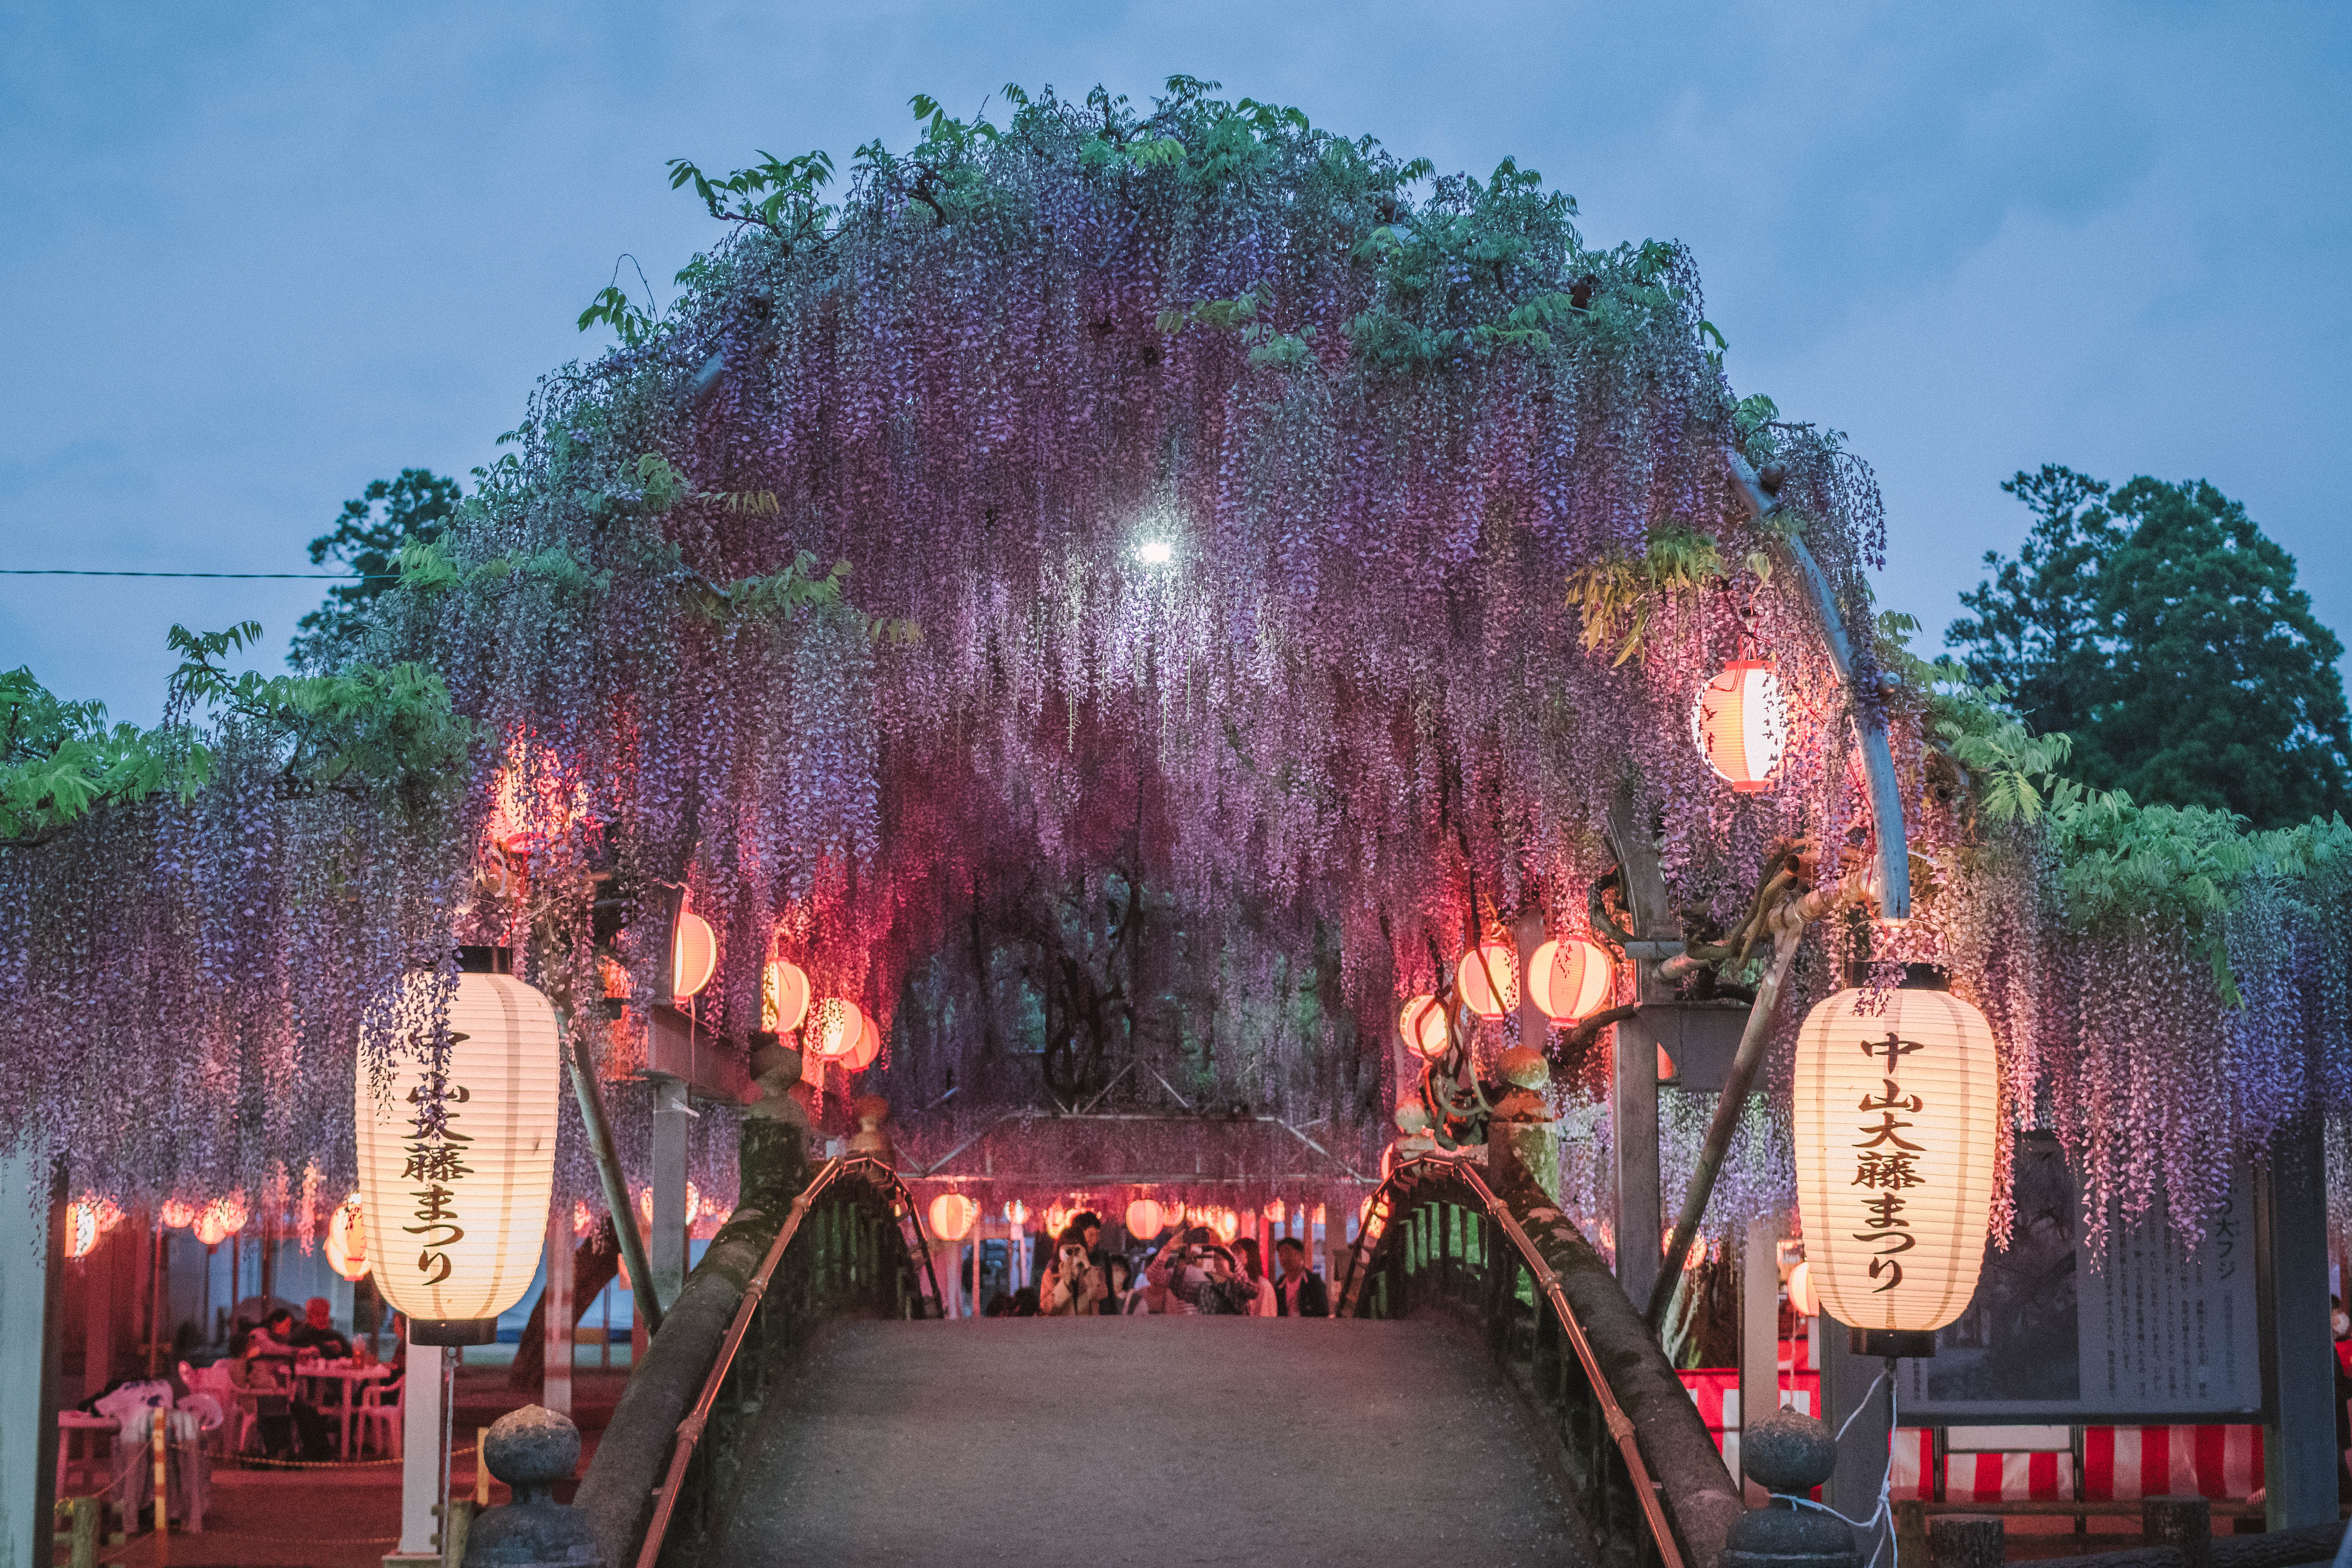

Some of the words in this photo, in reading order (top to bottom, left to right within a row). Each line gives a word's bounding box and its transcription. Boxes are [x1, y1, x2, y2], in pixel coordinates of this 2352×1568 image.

[1851, 1032, 1927, 1293] 中山大藤まつり
[2214, 1175, 2236, 1280] の大フジ
